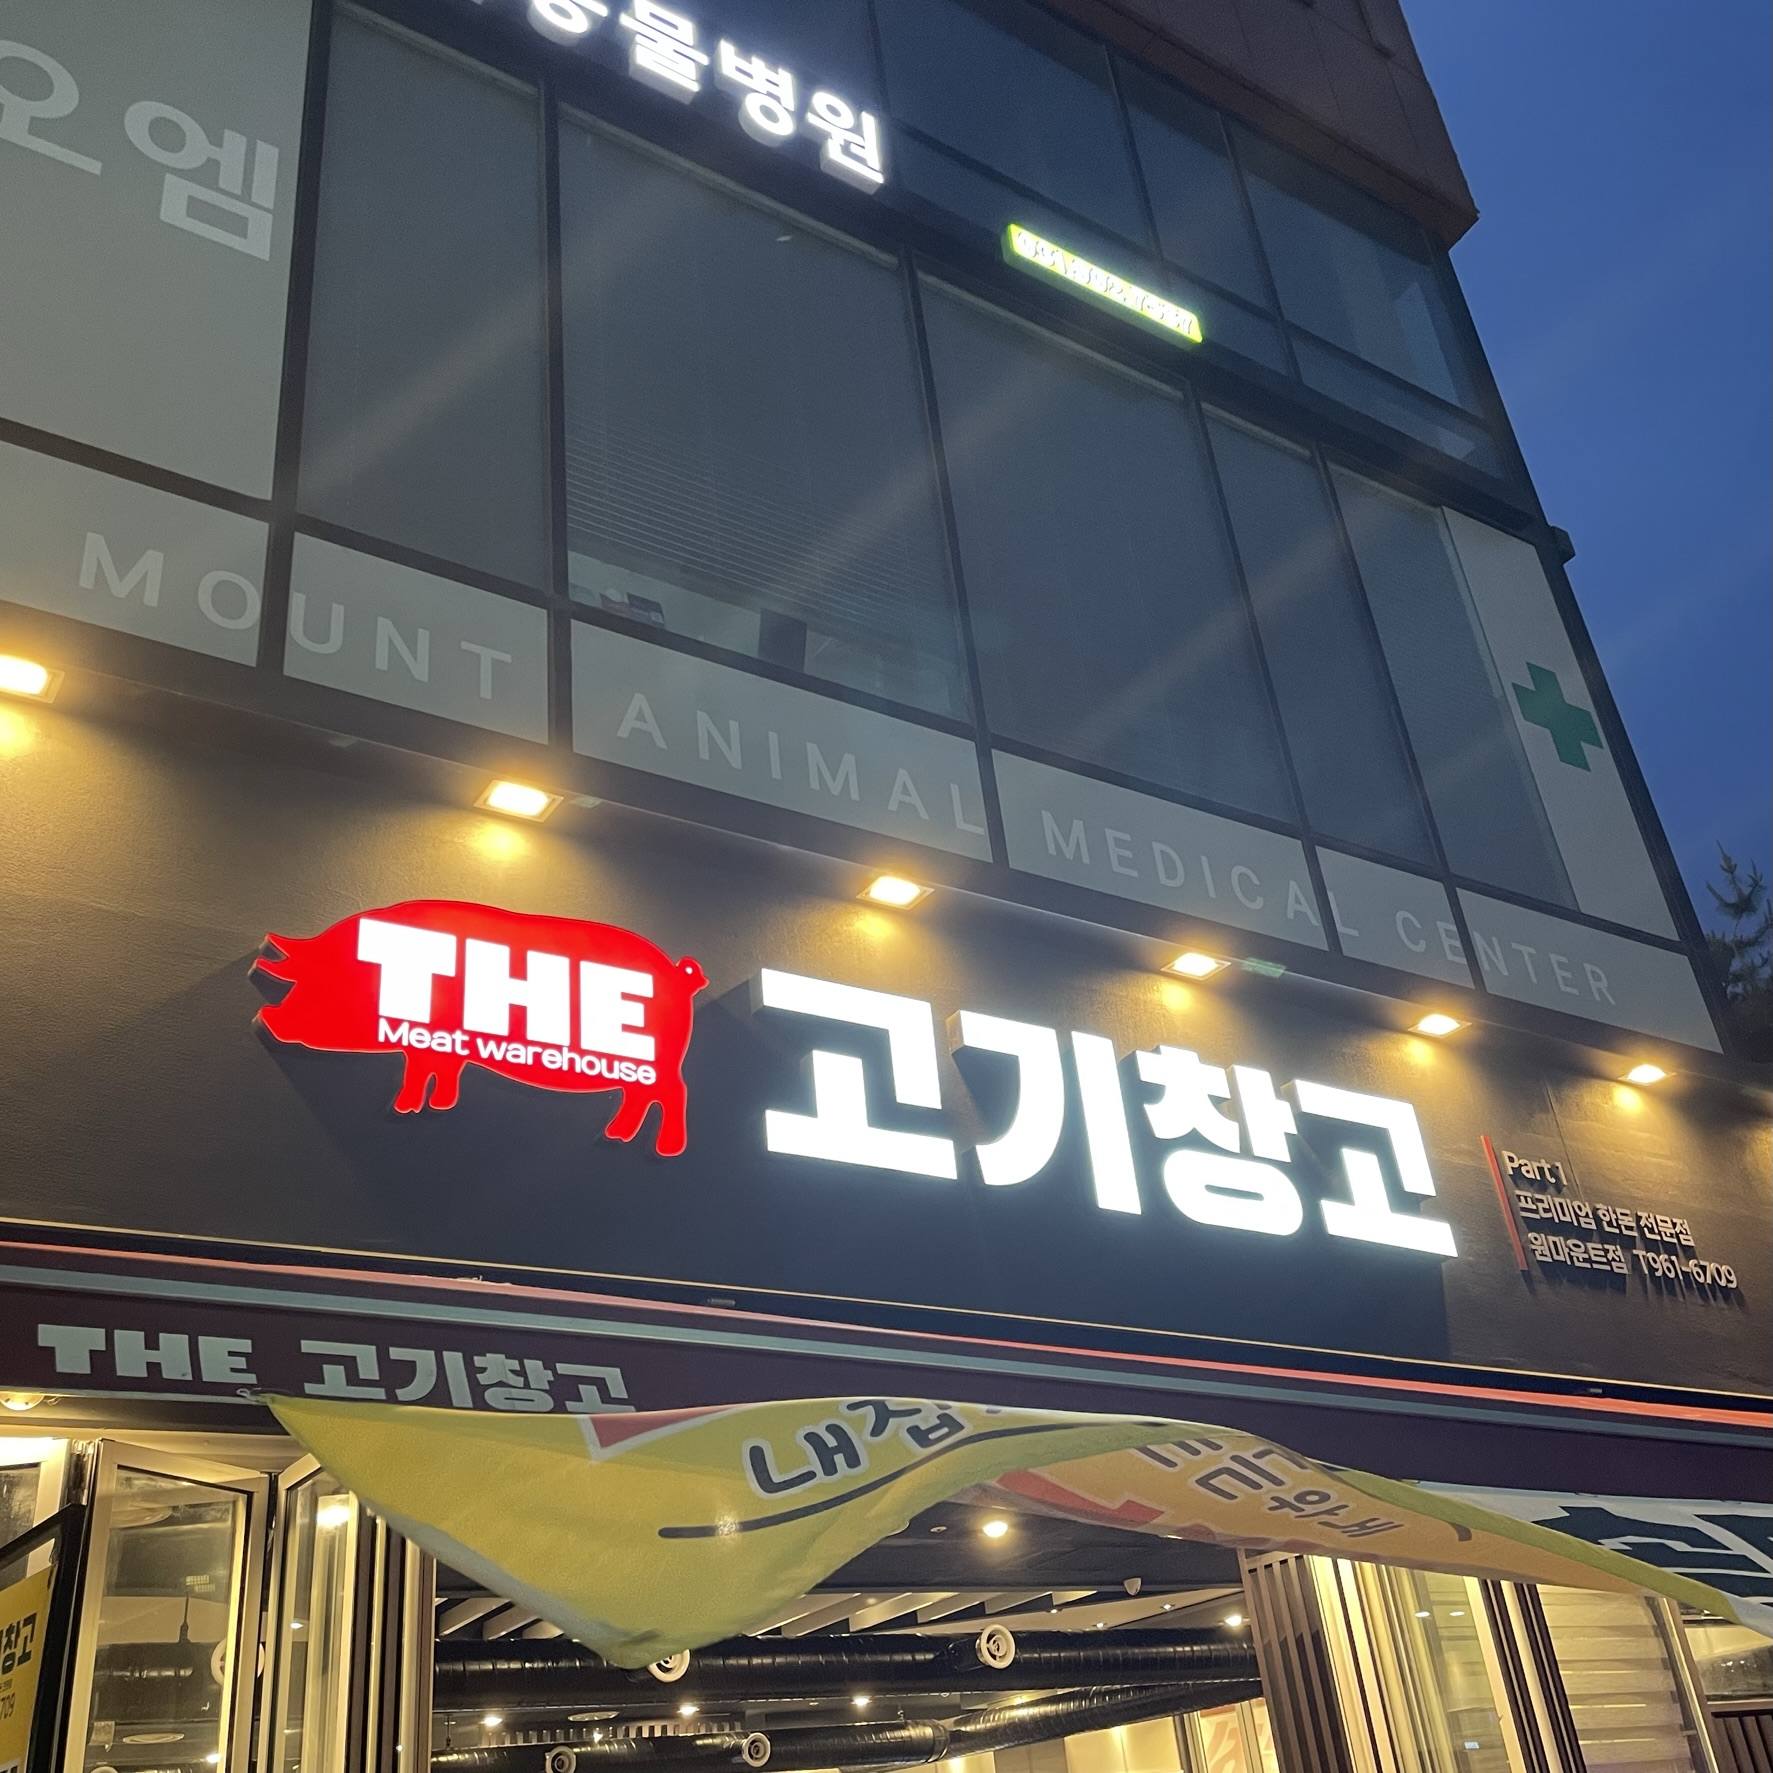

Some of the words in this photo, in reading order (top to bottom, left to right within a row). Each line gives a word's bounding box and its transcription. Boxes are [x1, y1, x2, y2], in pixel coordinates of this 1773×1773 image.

[79, 531, 512, 700] MOUNT
[616, 692, 986, 836] ANIMAL
[1041, 809, 1359, 937] MEDICAL
[1395, 910, 1617, 1006] CENTER
[357, 918, 655, 1061] THE
[378, 1017, 470, 1056] Meat
[479, 1040, 657, 1085] warehouse
[761, 967, 1458, 1258] 고기창고
[1514, 1190, 1597, 1230] 프리미엄
[1596, 1202, 1637, 1237] 한돈
[1637, 1210, 1695, 1247] 전문점
[1528, 1232, 1630, 1274] 원마운트점
[38, 1323, 257, 1384] THE
[300, 1339, 637, 1413] 고기창고
[0, 1612, 37, 1675] 창고
